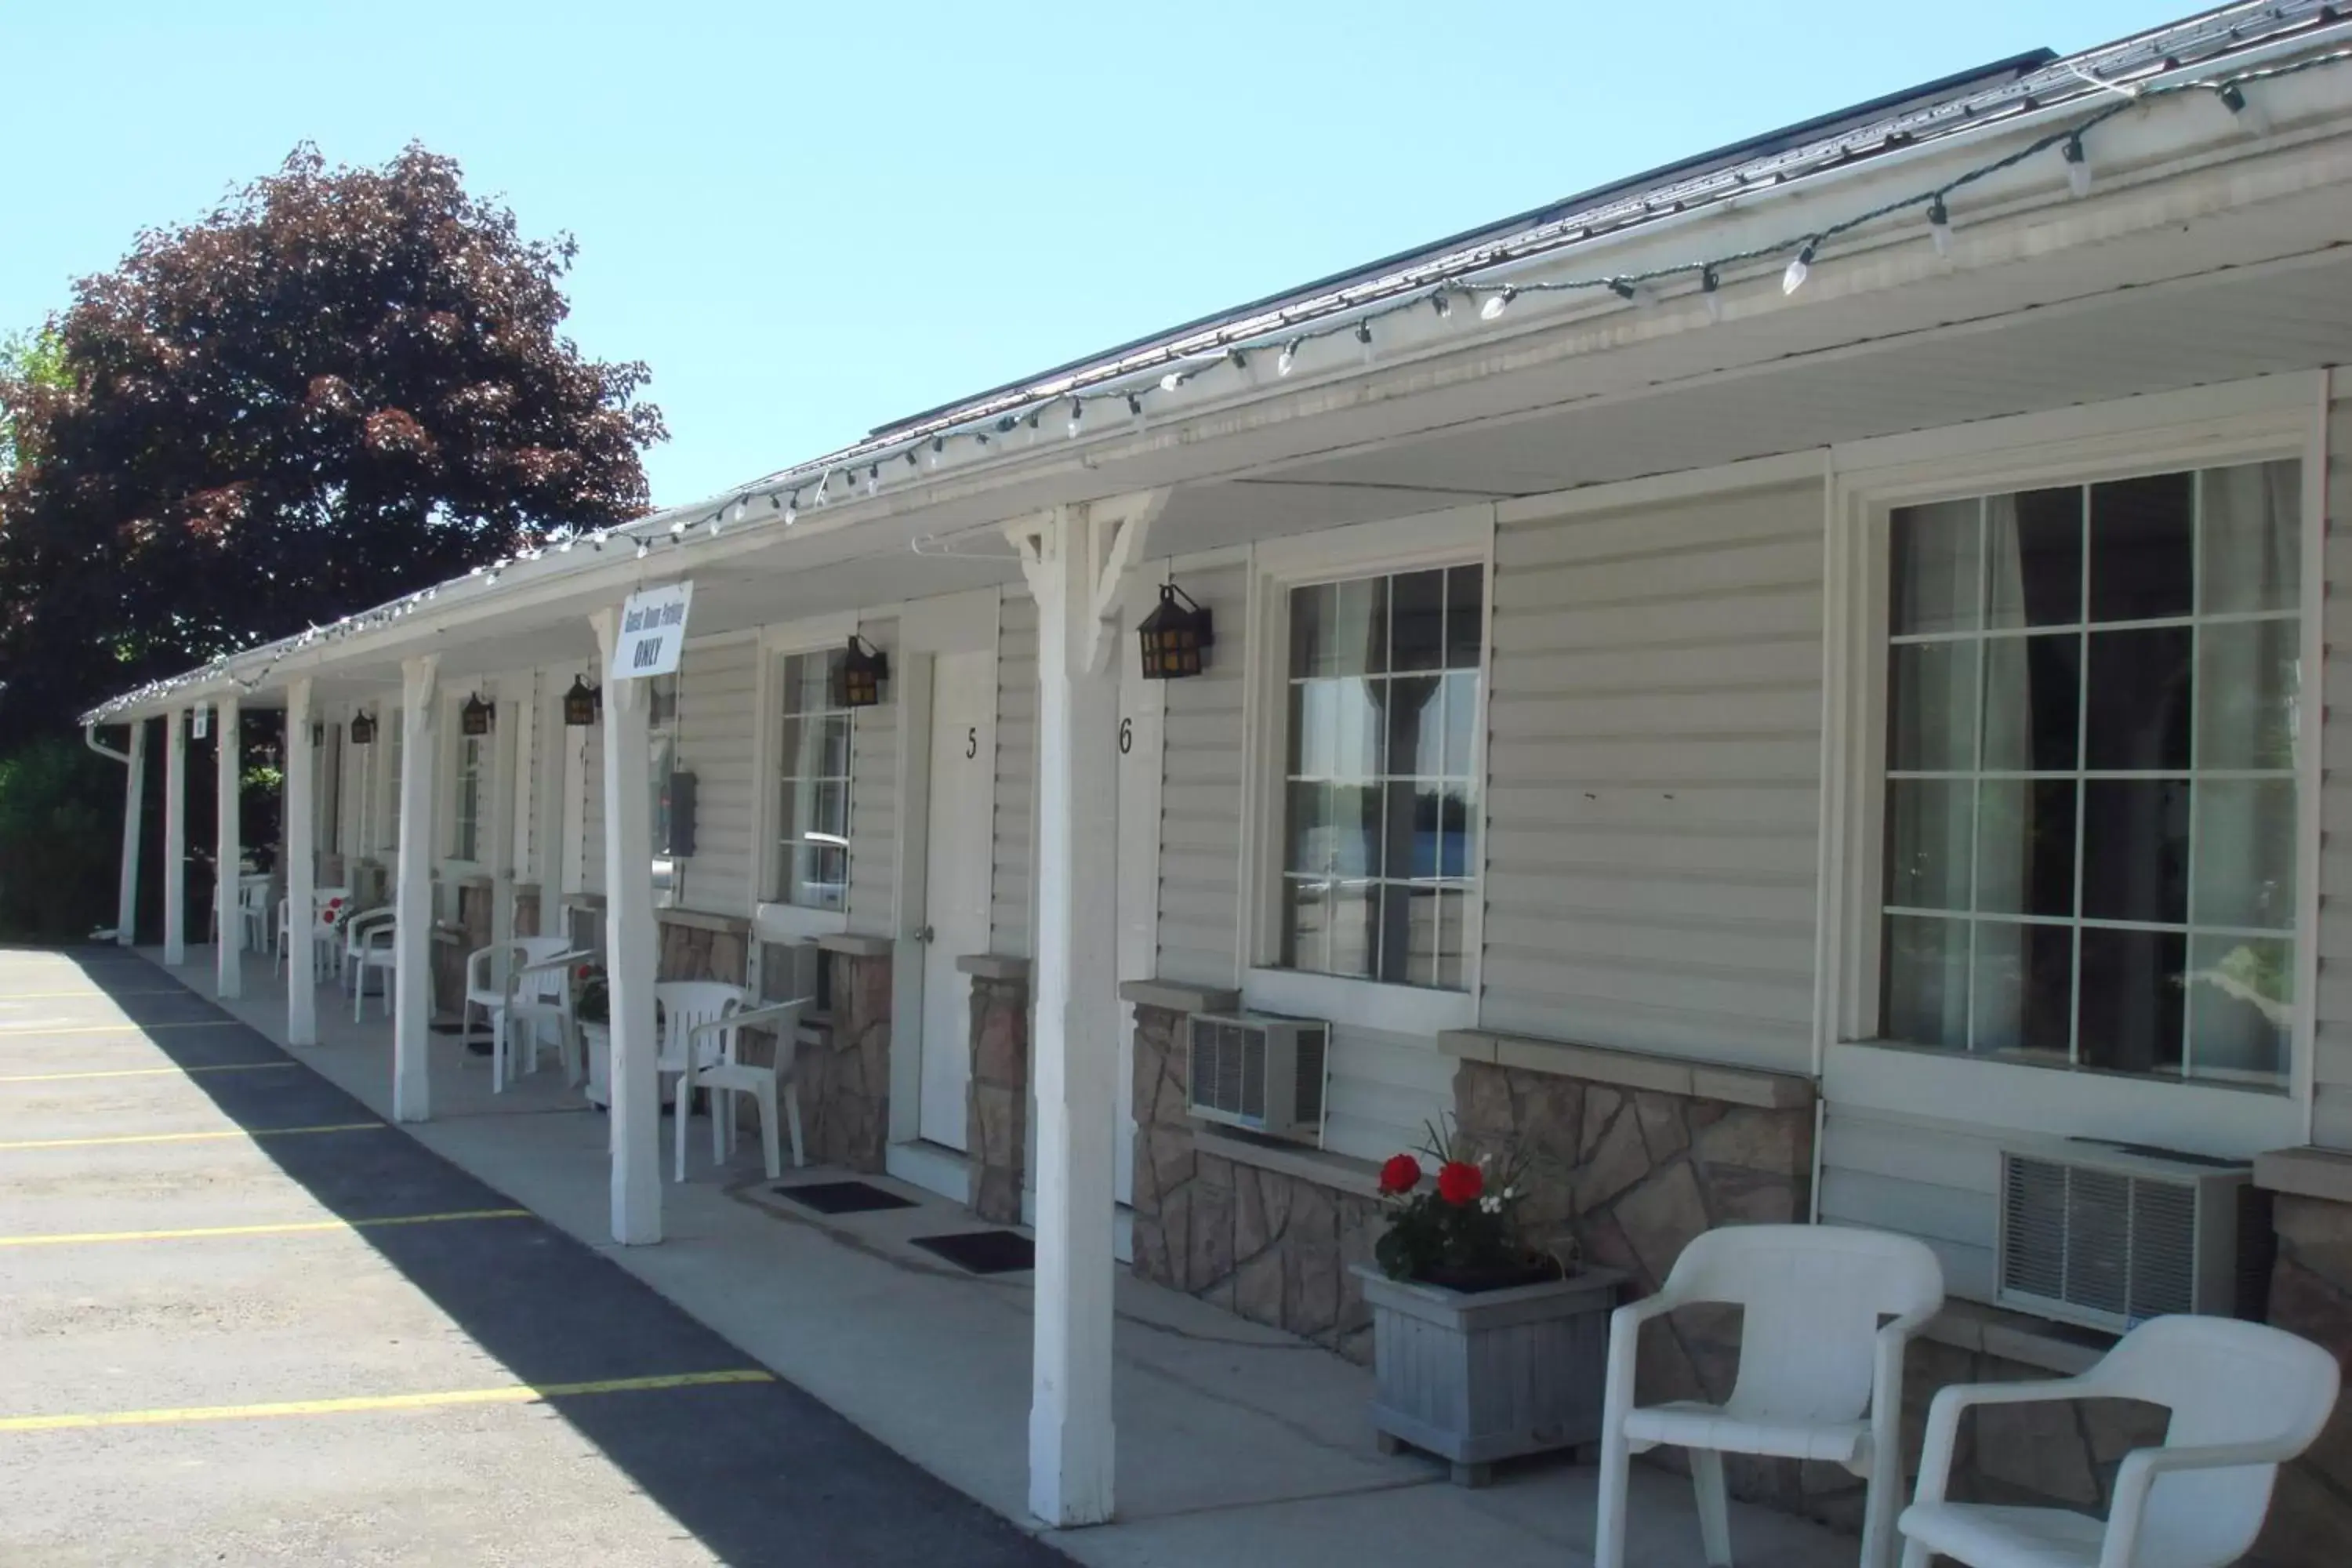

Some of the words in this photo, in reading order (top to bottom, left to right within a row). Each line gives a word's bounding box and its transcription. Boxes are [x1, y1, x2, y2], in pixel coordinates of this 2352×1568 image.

[633, 637, 663, 669] ONLY
[966, 727, 976, 759] 5
[1120, 717, 1131, 754] 6
